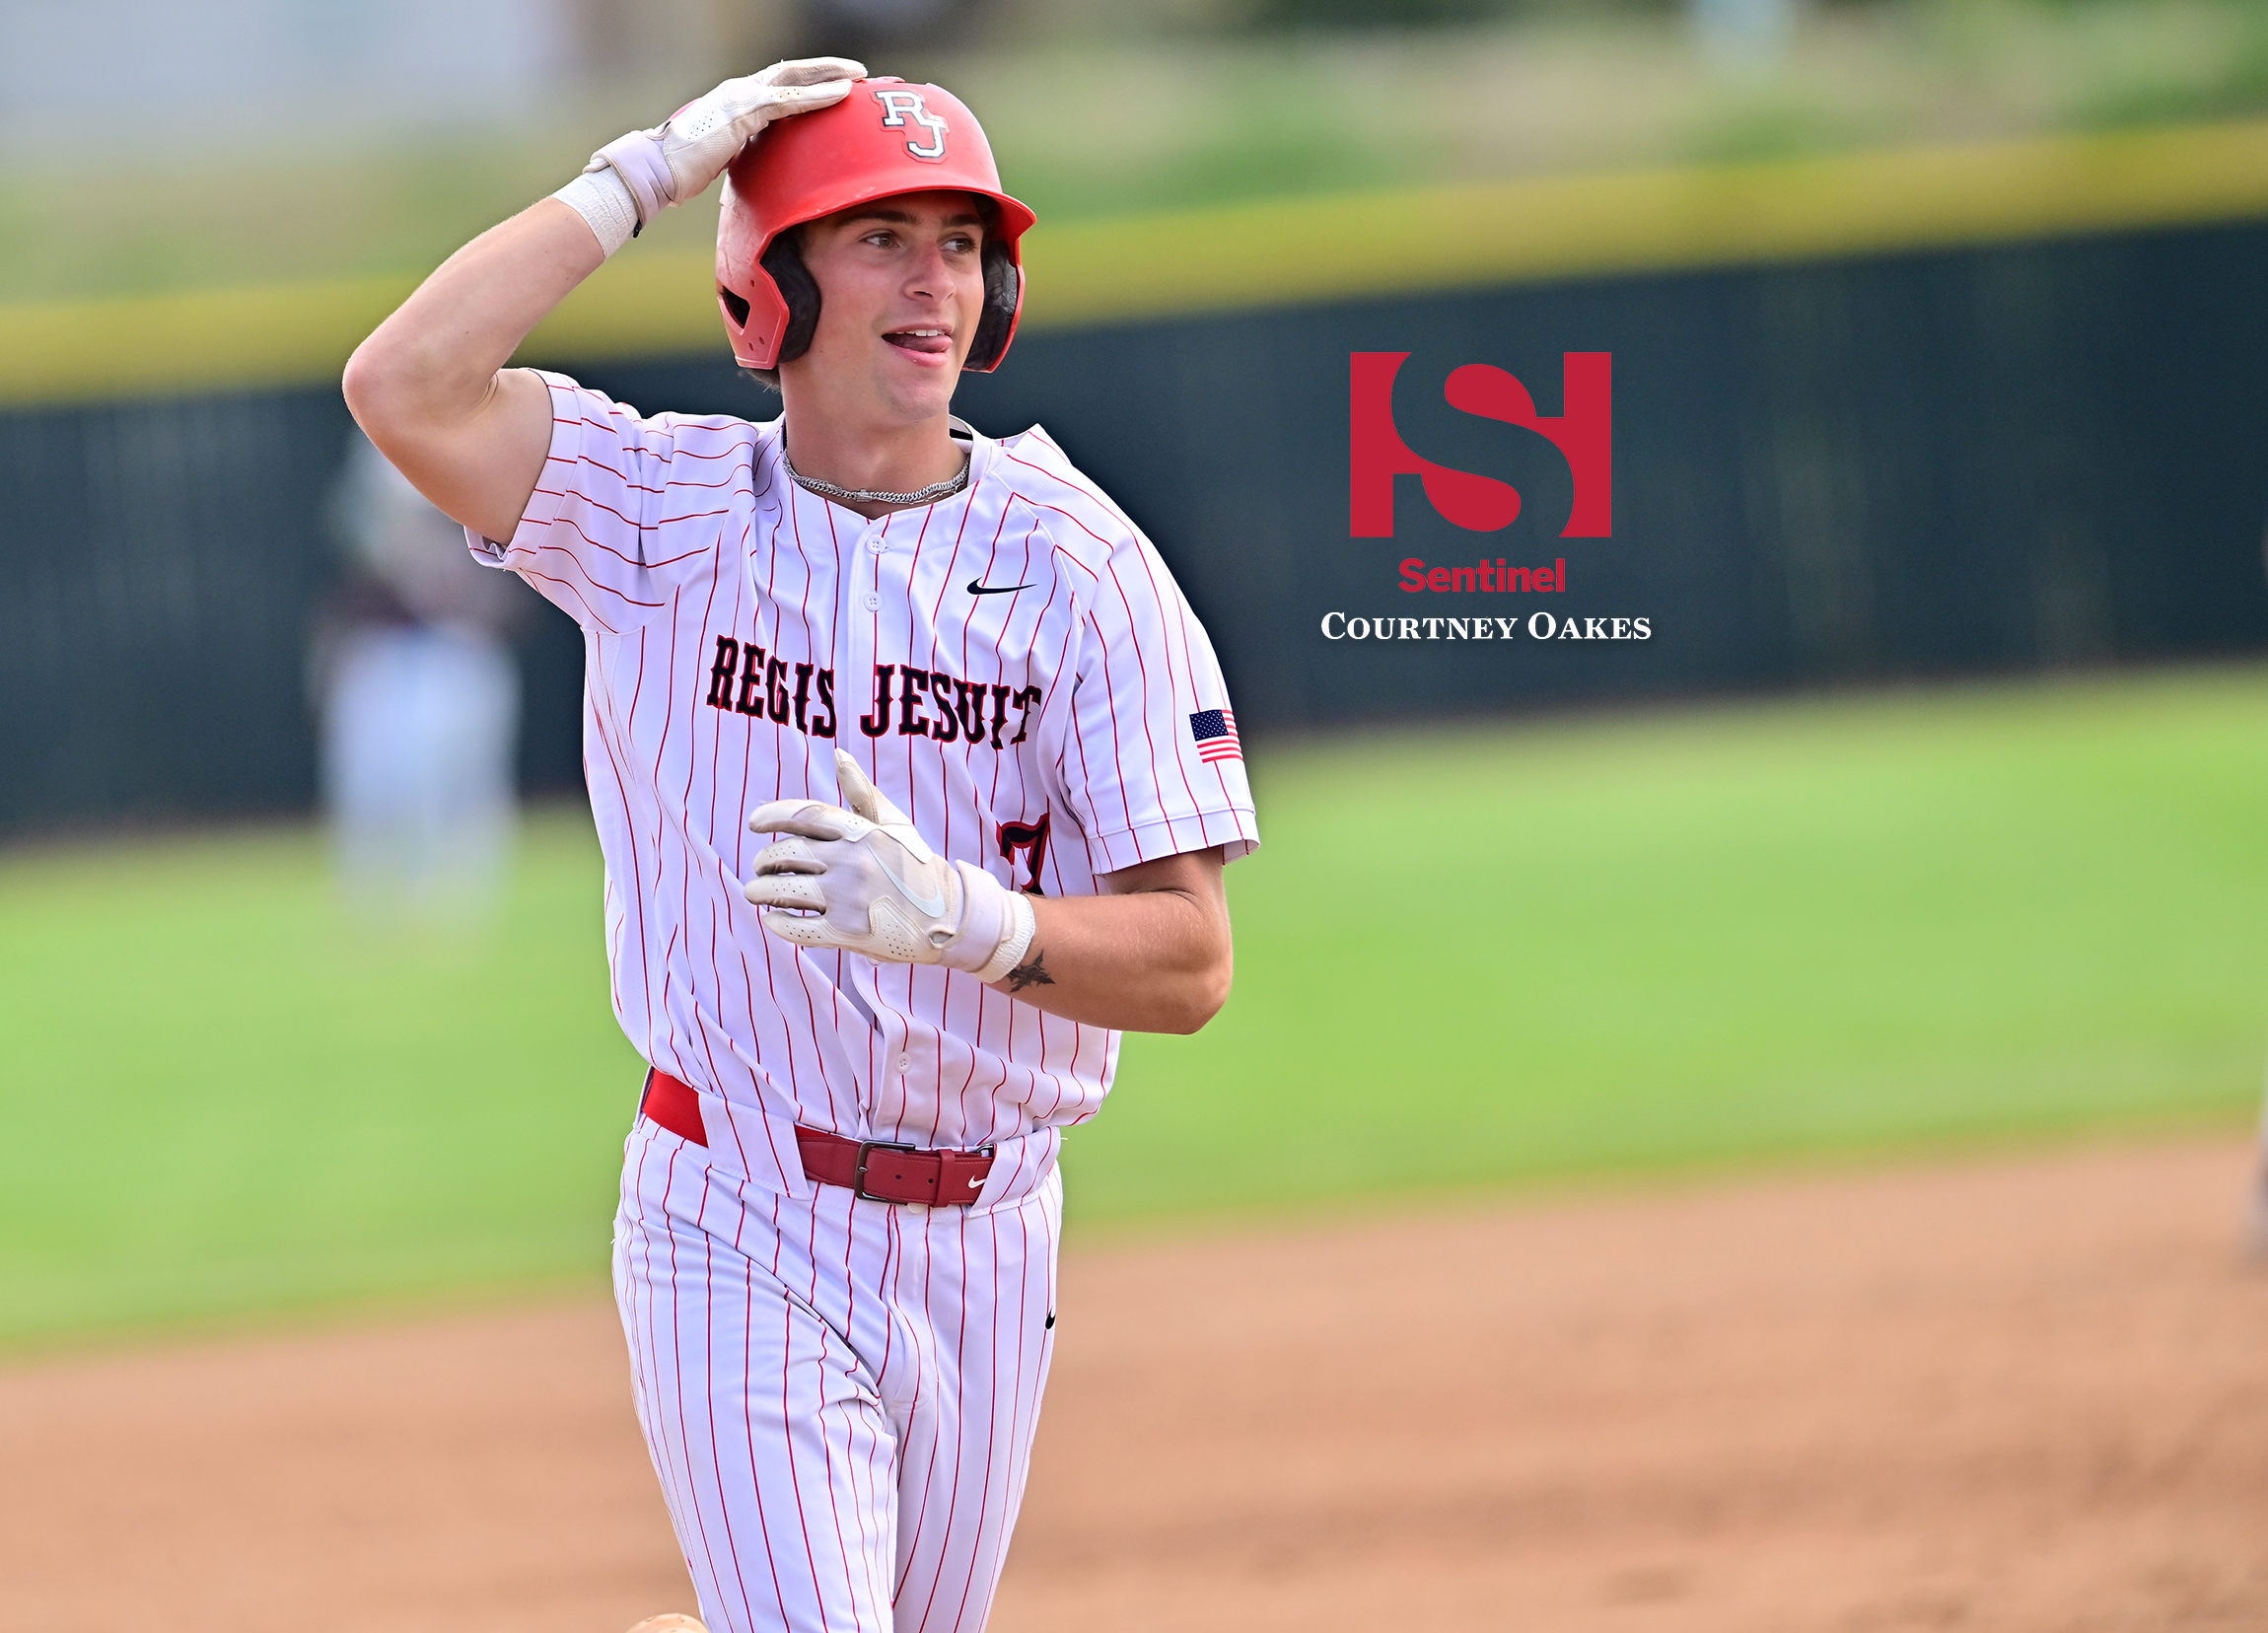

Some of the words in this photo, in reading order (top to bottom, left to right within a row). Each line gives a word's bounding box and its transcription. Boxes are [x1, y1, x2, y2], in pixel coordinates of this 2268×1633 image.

[706, 634, 836, 739] REGIS
[860, 664, 1042, 750] JESUIT
[995, 813, 1050, 895] 7
